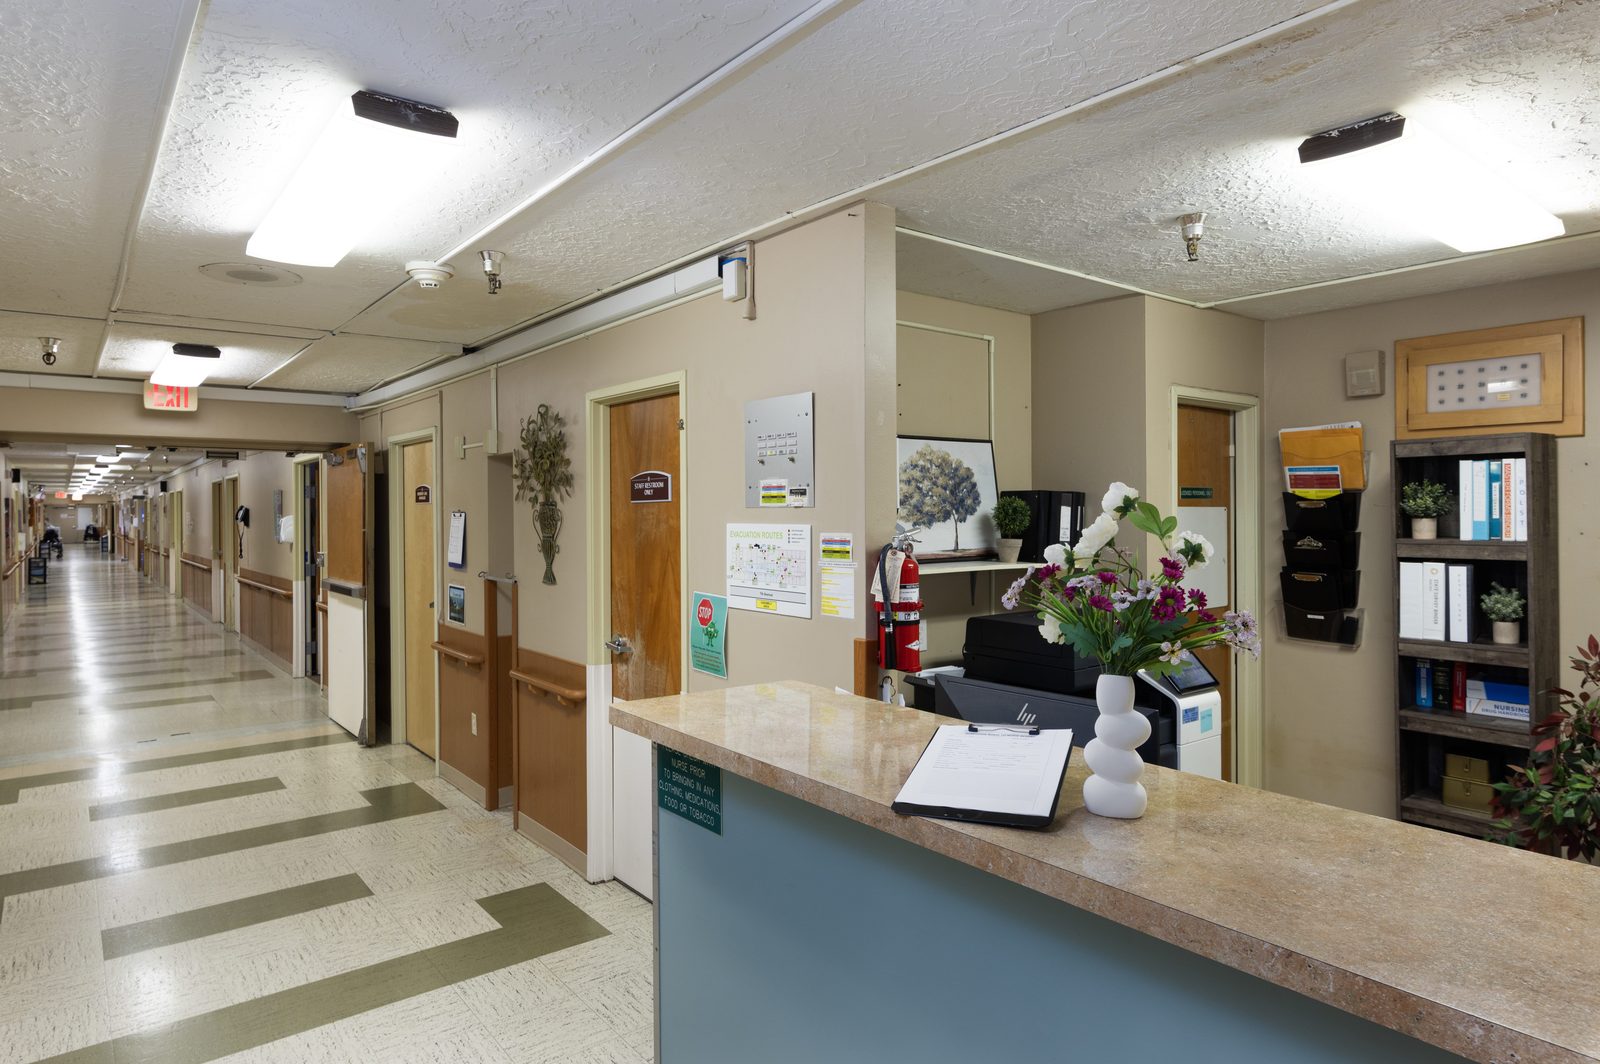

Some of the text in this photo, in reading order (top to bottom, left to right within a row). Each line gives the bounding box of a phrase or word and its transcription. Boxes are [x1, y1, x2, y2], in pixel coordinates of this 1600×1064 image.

[634, 481, 665, 490] STAFF RESTROOM
[730, 528, 761, 538] EVACUATION
[761, 530, 784, 539] ROUTES
[698, 606, 712, 619] STOP
[671, 758, 688, 773] NURSE
[689, 764, 706, 780] PRIOR
[664, 768, 715, 798] TO BRINGING IN ANY
[664, 795, 715, 827] FOOD OR TOBACCO
